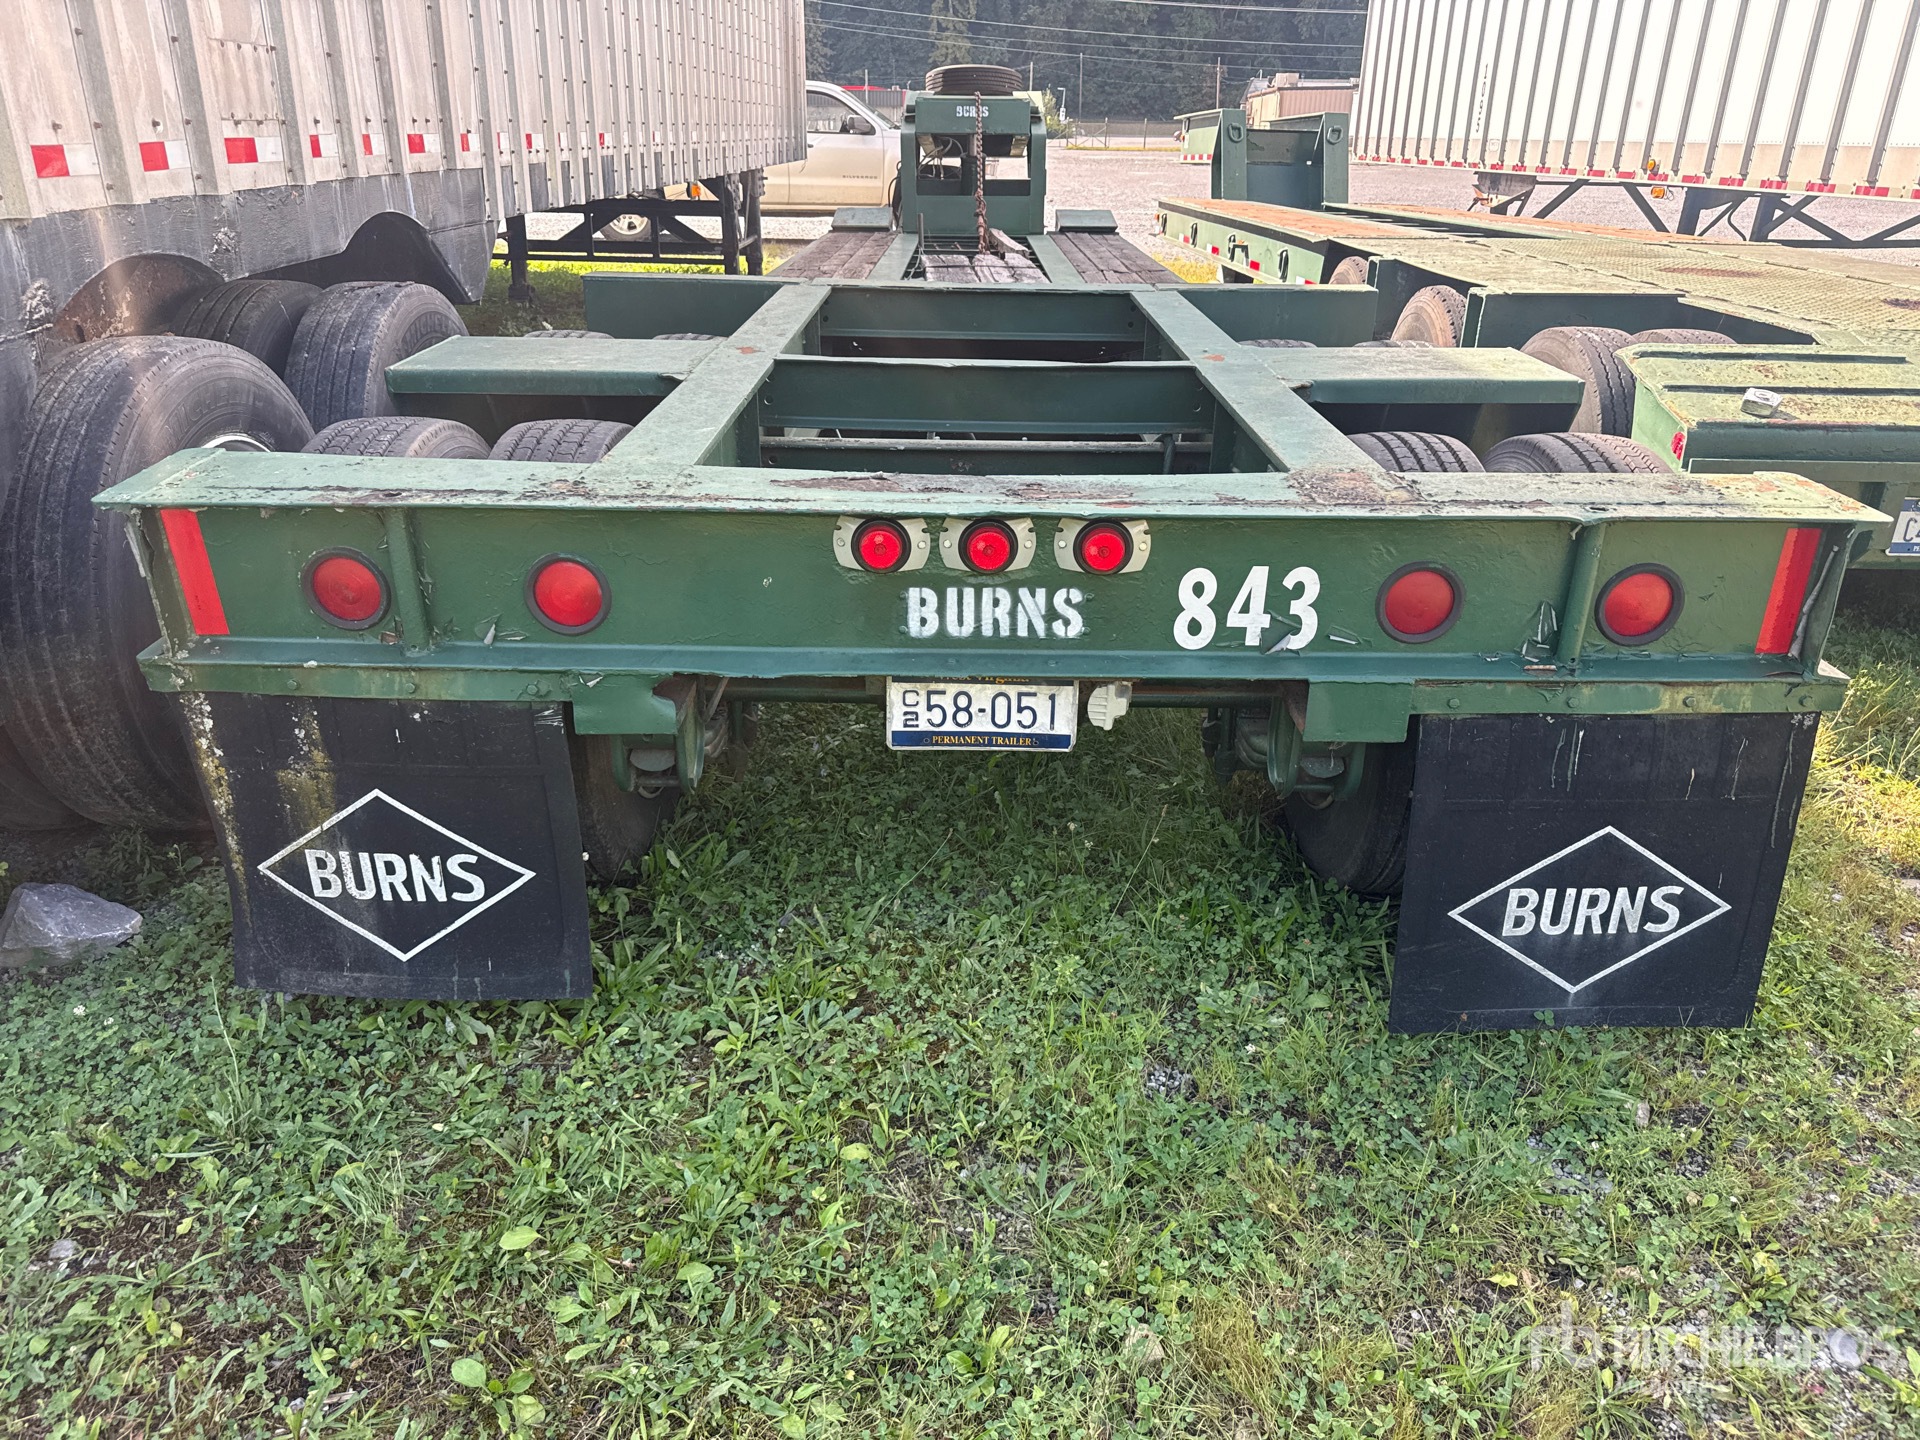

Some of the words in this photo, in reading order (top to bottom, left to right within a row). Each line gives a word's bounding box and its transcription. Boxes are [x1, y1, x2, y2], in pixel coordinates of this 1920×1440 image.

[906, 586, 1086, 639] BURNS
[1173, 565, 1322, 651] 843
[926, 689, 1057, 731] 58-051
[932, 735, 989, 745] PERMANENT
[992, 736, 1032, 746] TRAILER
[304, 849, 486, 902] BURNS
[1502, 885, 1685, 936] BURNS
